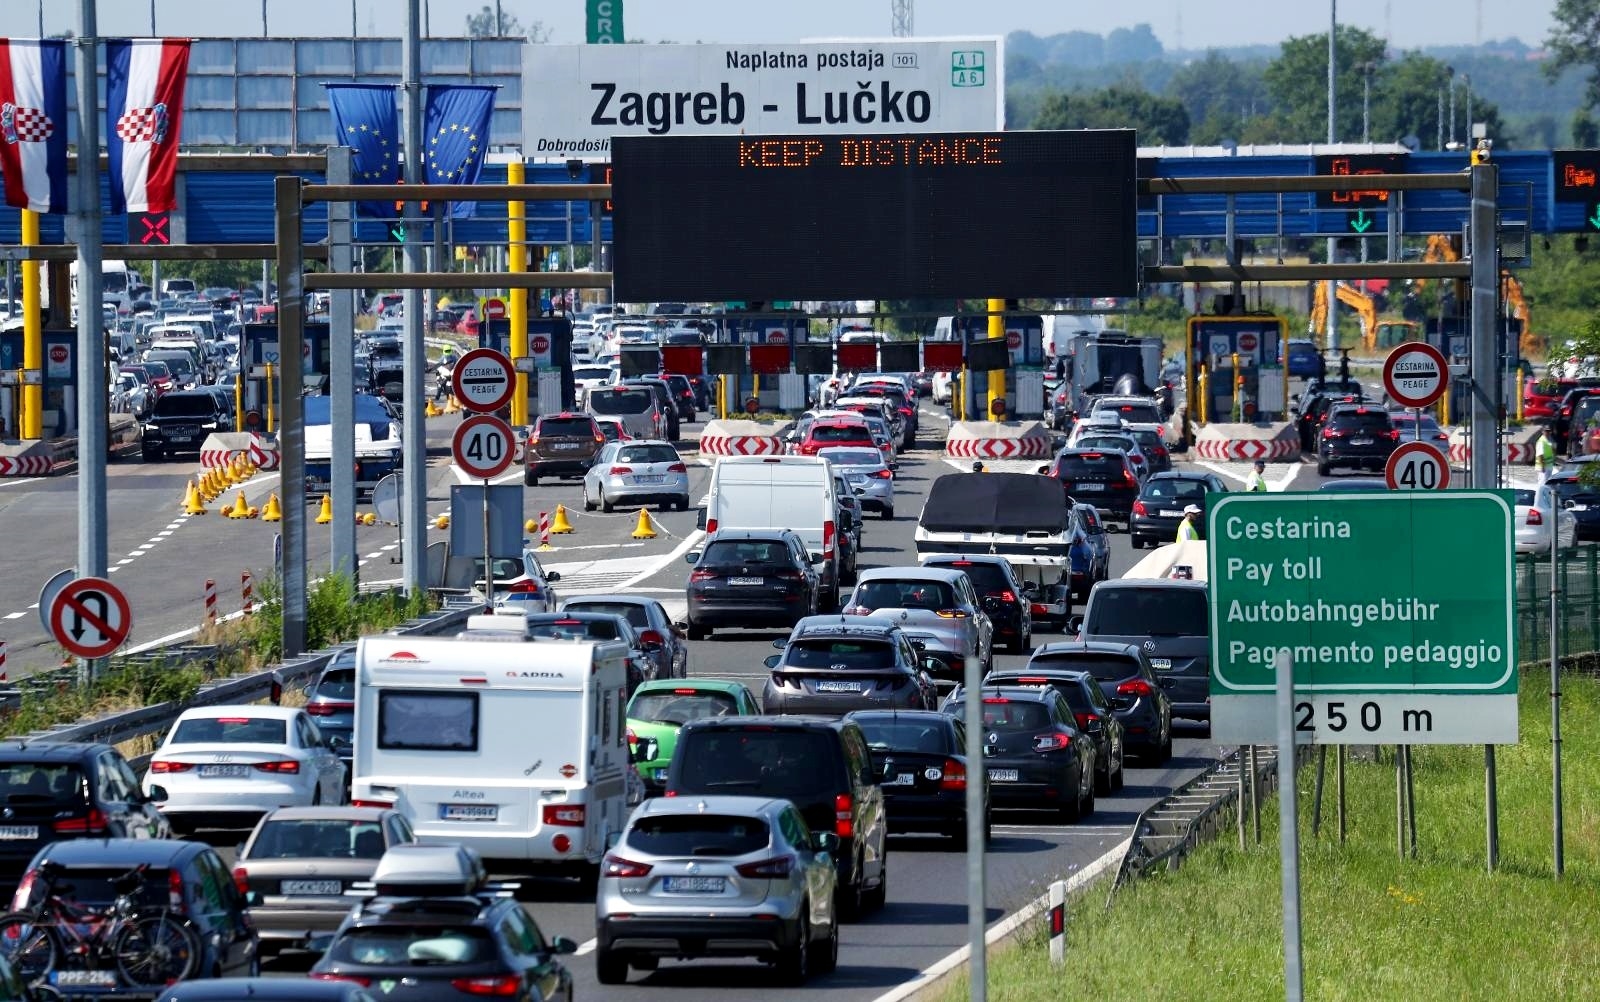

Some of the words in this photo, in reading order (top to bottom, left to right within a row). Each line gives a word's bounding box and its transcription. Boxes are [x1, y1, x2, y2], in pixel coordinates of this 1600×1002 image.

[727, 51, 807, 72] Naplatna
[818, 50, 884, 71] postaja
[591, 83, 745, 135] Zagreb
[797, 81, 931, 125] Lučko
[538, 139, 609, 152] Dobrodošli
[740, 141, 823, 167] KEEP
[840, 138, 1002, 166] DISTANCE
[464, 367, 503, 377] CESTARINA
[1395, 362, 1435, 371] CESTARINA
[471, 384, 497, 394] PEAGE
[1403, 380, 1429, 389] PEAGE
[467, 432, 501, 461] 40
[1400, 460, 1436, 489] 40
[1226, 515, 1351, 539] Cestarina
[1227, 557, 1273, 586] Pay
[1282, 556, 1322, 580] toll
[1227, 597, 1440, 628] Autobahngebühr
[1229, 640, 1374, 669] Pagmento
[1384, 639, 1501, 668] pedaggio
[520, 671, 564, 679] ADRIA
[1294, 701, 1382, 732] 250
[1402, 708, 1433, 732] m
[453, 790, 485, 799] Altea
